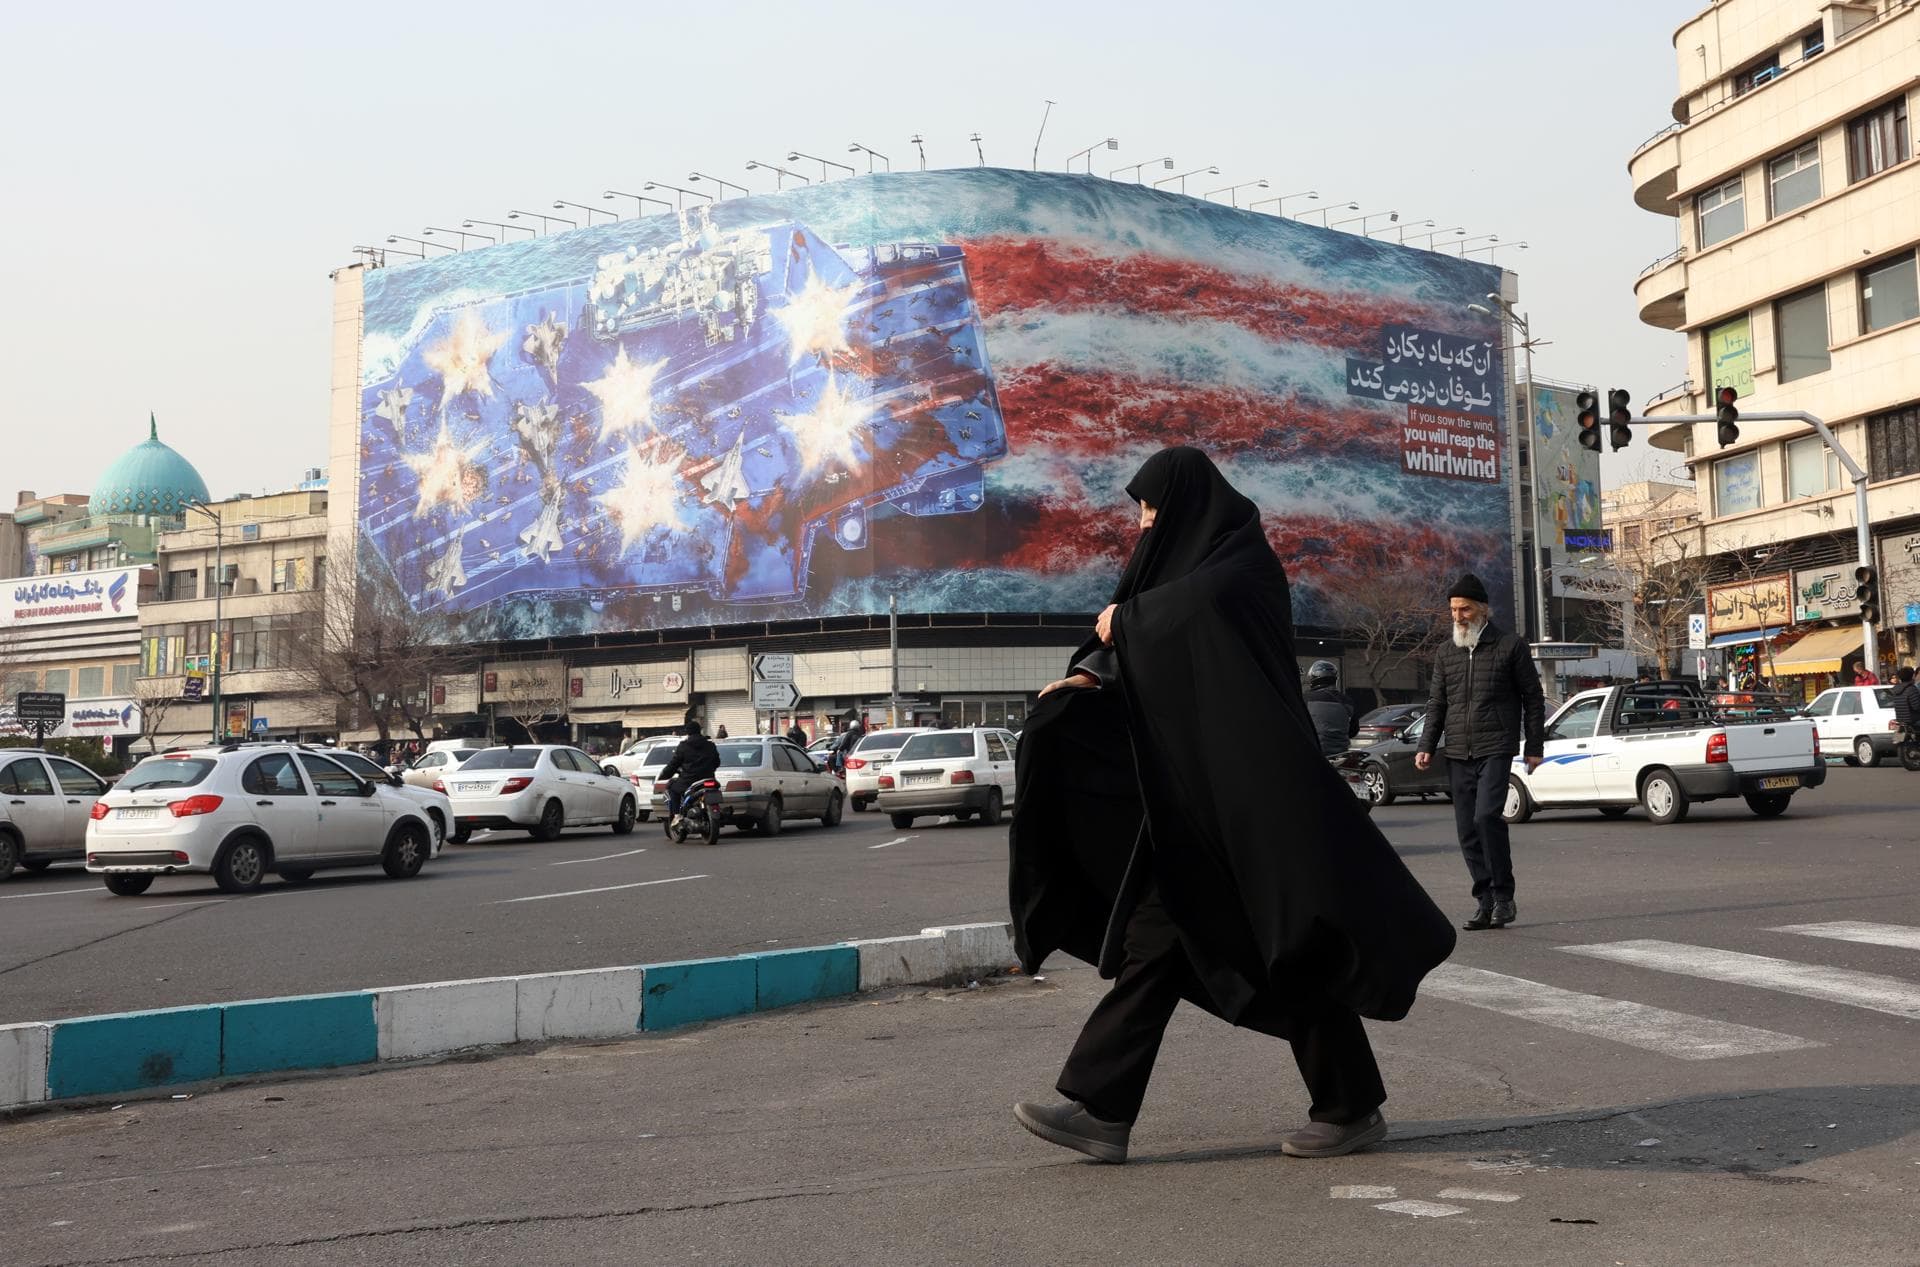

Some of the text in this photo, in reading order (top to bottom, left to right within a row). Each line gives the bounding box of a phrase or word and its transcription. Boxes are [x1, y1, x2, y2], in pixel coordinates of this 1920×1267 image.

[1386, 331, 1493, 376] آن که باد بکارد
[1435, 376, 1492, 411] طوفان
[1410, 409, 1495, 434] If you sow the wind,
[1404, 428, 1495, 452] you will reap the
[1405, 446, 1496, 479] whirlwind
[14, 582, 49, 604] کارگران
[75, 579, 103, 599] بانک
